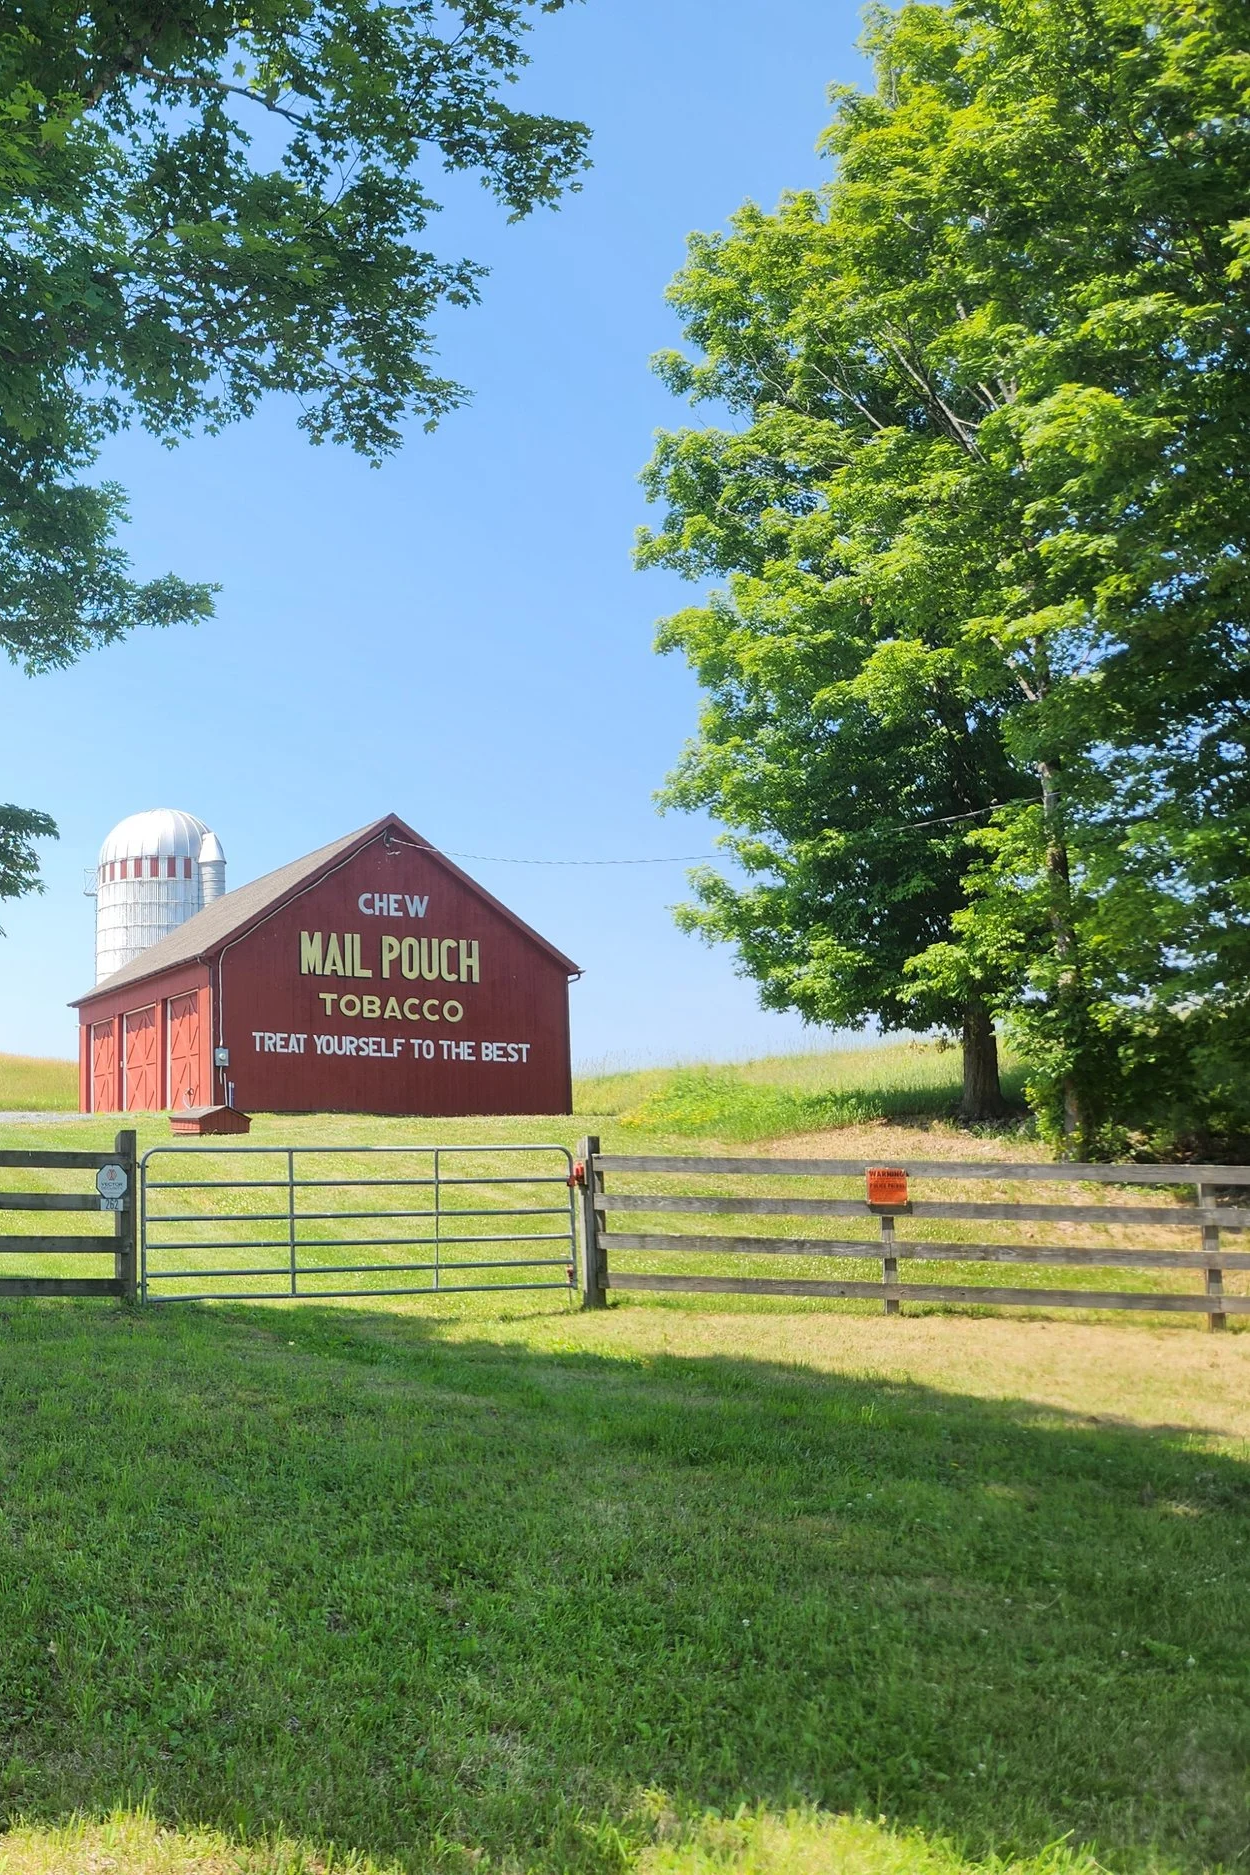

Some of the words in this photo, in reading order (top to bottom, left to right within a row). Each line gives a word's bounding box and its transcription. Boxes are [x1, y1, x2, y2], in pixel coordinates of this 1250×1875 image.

[358, 893, 429, 918] CHEW
[300, 931, 372, 978] MAIL
[382, 935, 480, 983] POUCH
[319, 993, 464, 1023] TOBACCO
[252, 1031, 307, 1054] TREAT
[313, 1034, 405, 1058] YOURSELF
[410, 1039, 435, 1059] TO
[439, 1040, 476, 1061] THE
[481, 1042, 530, 1063] BEST
[105, 1199, 119, 1209] 262
